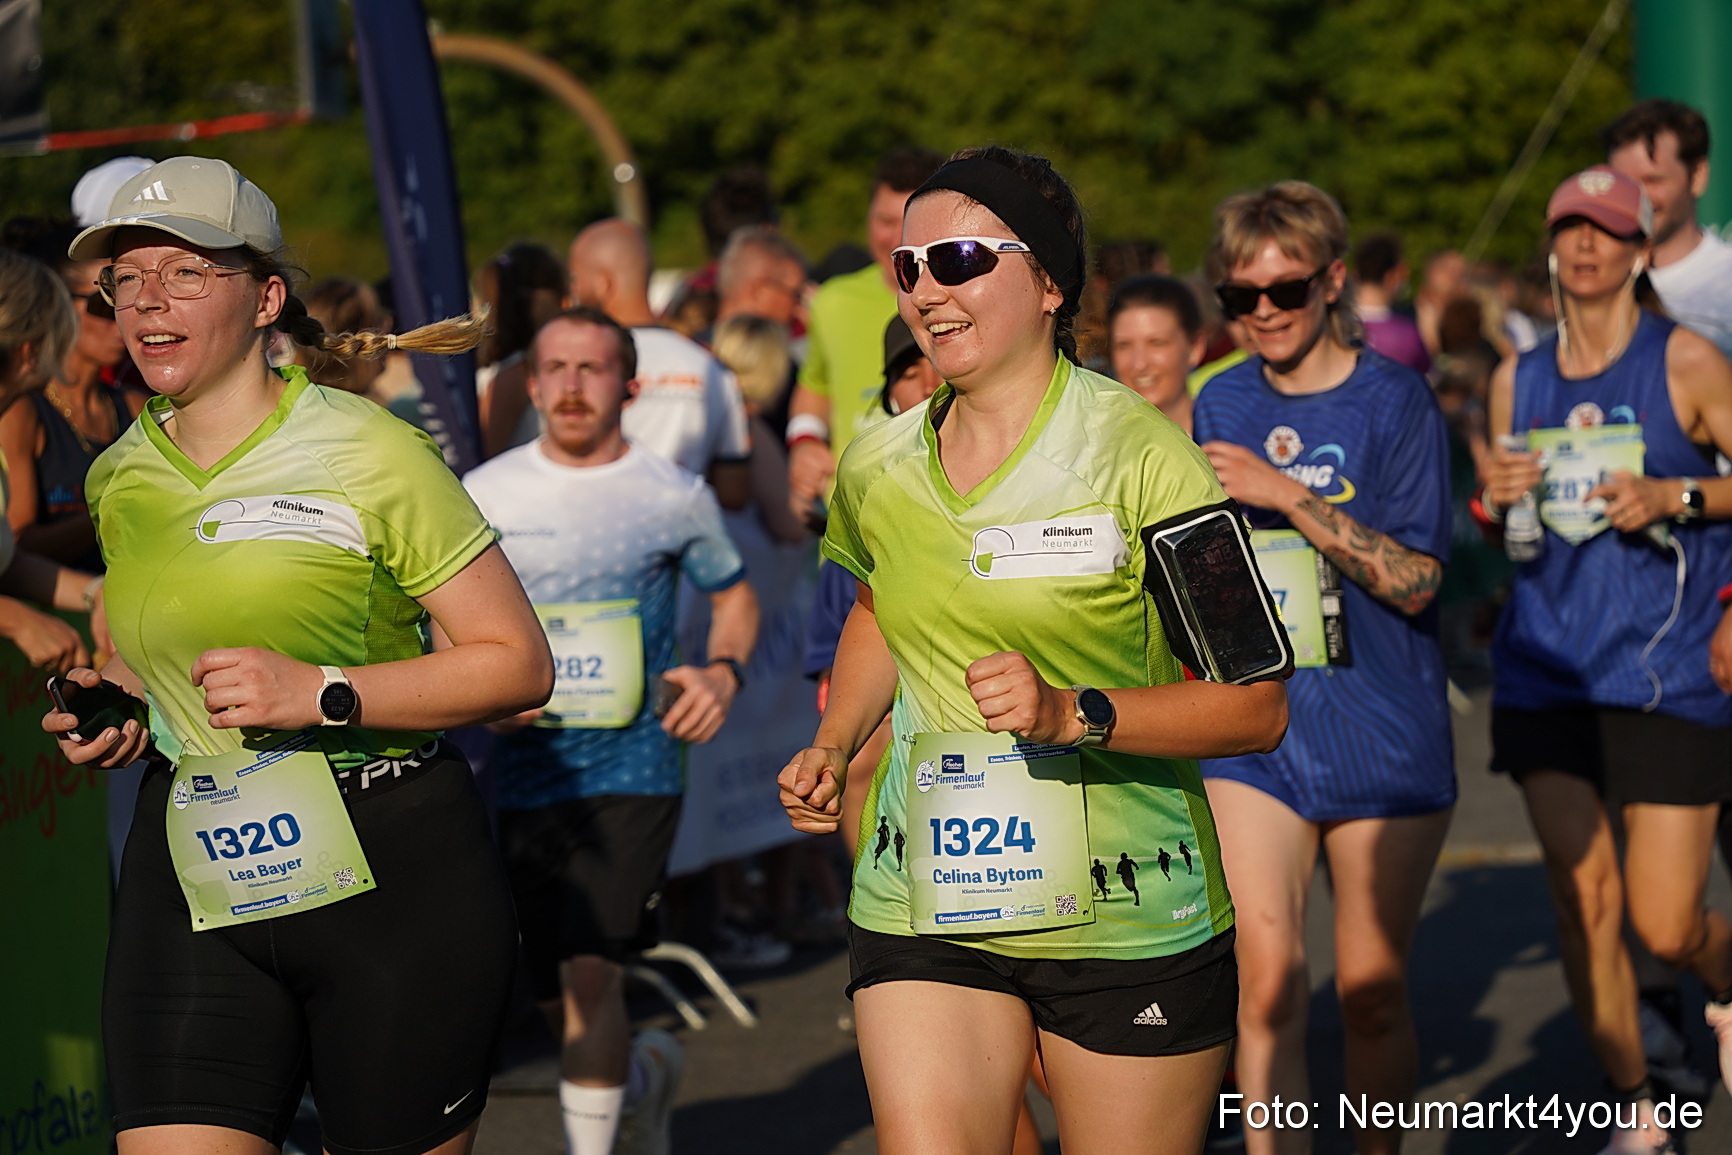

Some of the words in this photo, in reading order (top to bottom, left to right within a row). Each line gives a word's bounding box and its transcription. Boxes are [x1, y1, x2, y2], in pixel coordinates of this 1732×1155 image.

[272, 500, 324, 516] Klinikum
[270, 510, 322, 525] Neumarkt
[1042, 527, 1093, 537] Klinikum
[1042, 539, 1093, 548] Neumarkt
[935, 771, 985, 785] Firmenlauf
[953, 782, 985, 790] neumarkt
[190, 785, 239, 803] Firmenlauf
[210, 794, 241, 806] neumarkt
[195, 813, 302, 861] 1320
[930, 816, 1036, 856] 1324
[228, 868, 256, 882] Lea
[257, 857, 302, 877] Bayer
[933, 868, 982, 884] Celina
[986, 868, 1043, 885] Bytom
[248, 880, 269, 888] Klinikum
[268, 875, 293, 885] Neumarkt
[234, 898, 286, 914] firmenlauf.bayern
[1015, 907, 1046, 917] Firmenlauf
[937, 911, 998, 923] firmenlauf.bayern
[1133, 1016, 1168, 1026] adidas
